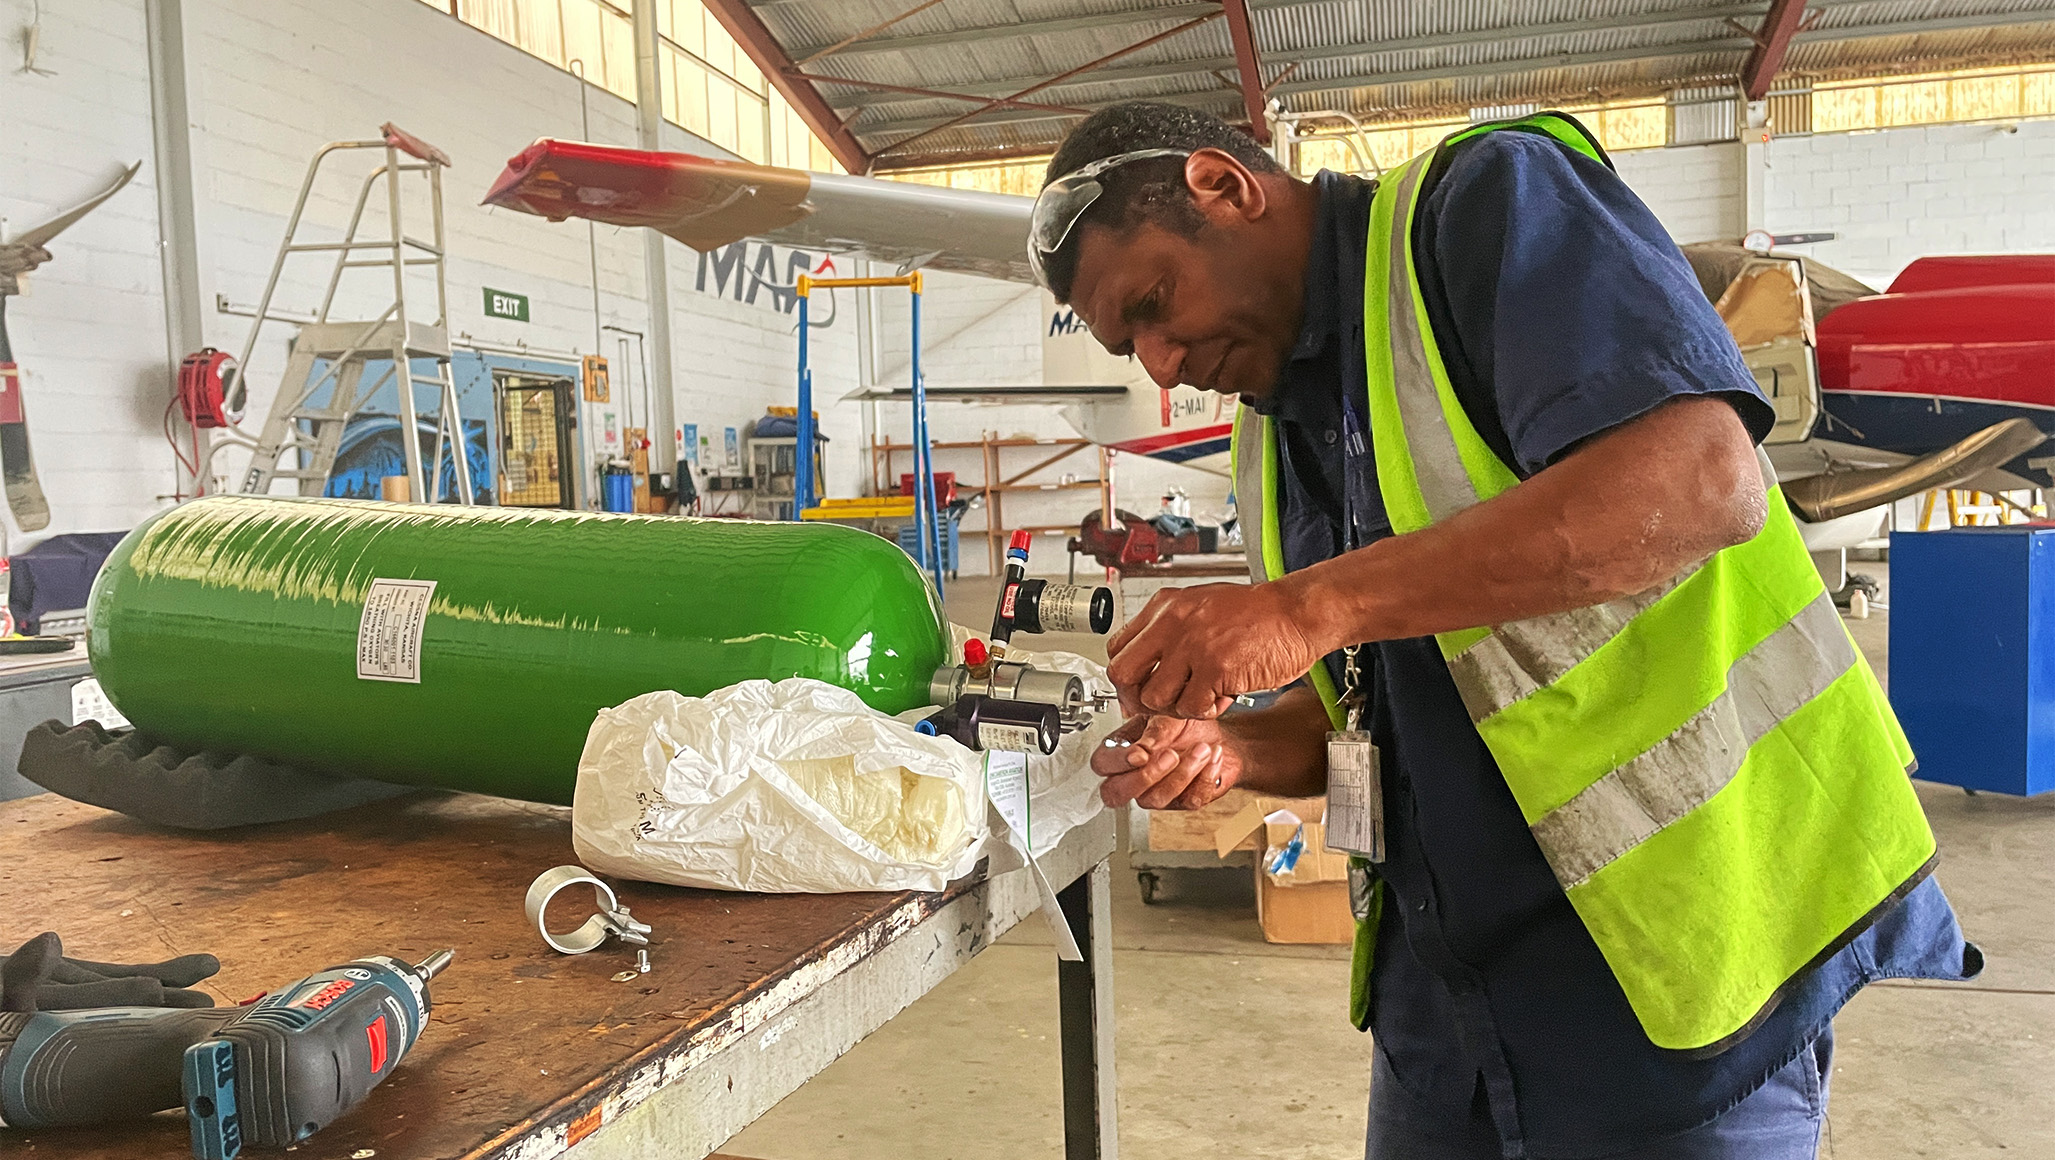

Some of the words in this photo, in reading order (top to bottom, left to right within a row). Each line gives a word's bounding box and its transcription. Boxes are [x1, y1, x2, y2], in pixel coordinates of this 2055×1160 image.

[493, 294, 520, 317] EXIT
[1167, 397, 1205, 418] 2-MAI
[370, 596, 376, 605] TO
[413, 594, 424, 621] CESSNA
[371, 594, 383, 633] BREATHING
[303, 980, 355, 1011] BOSCH
